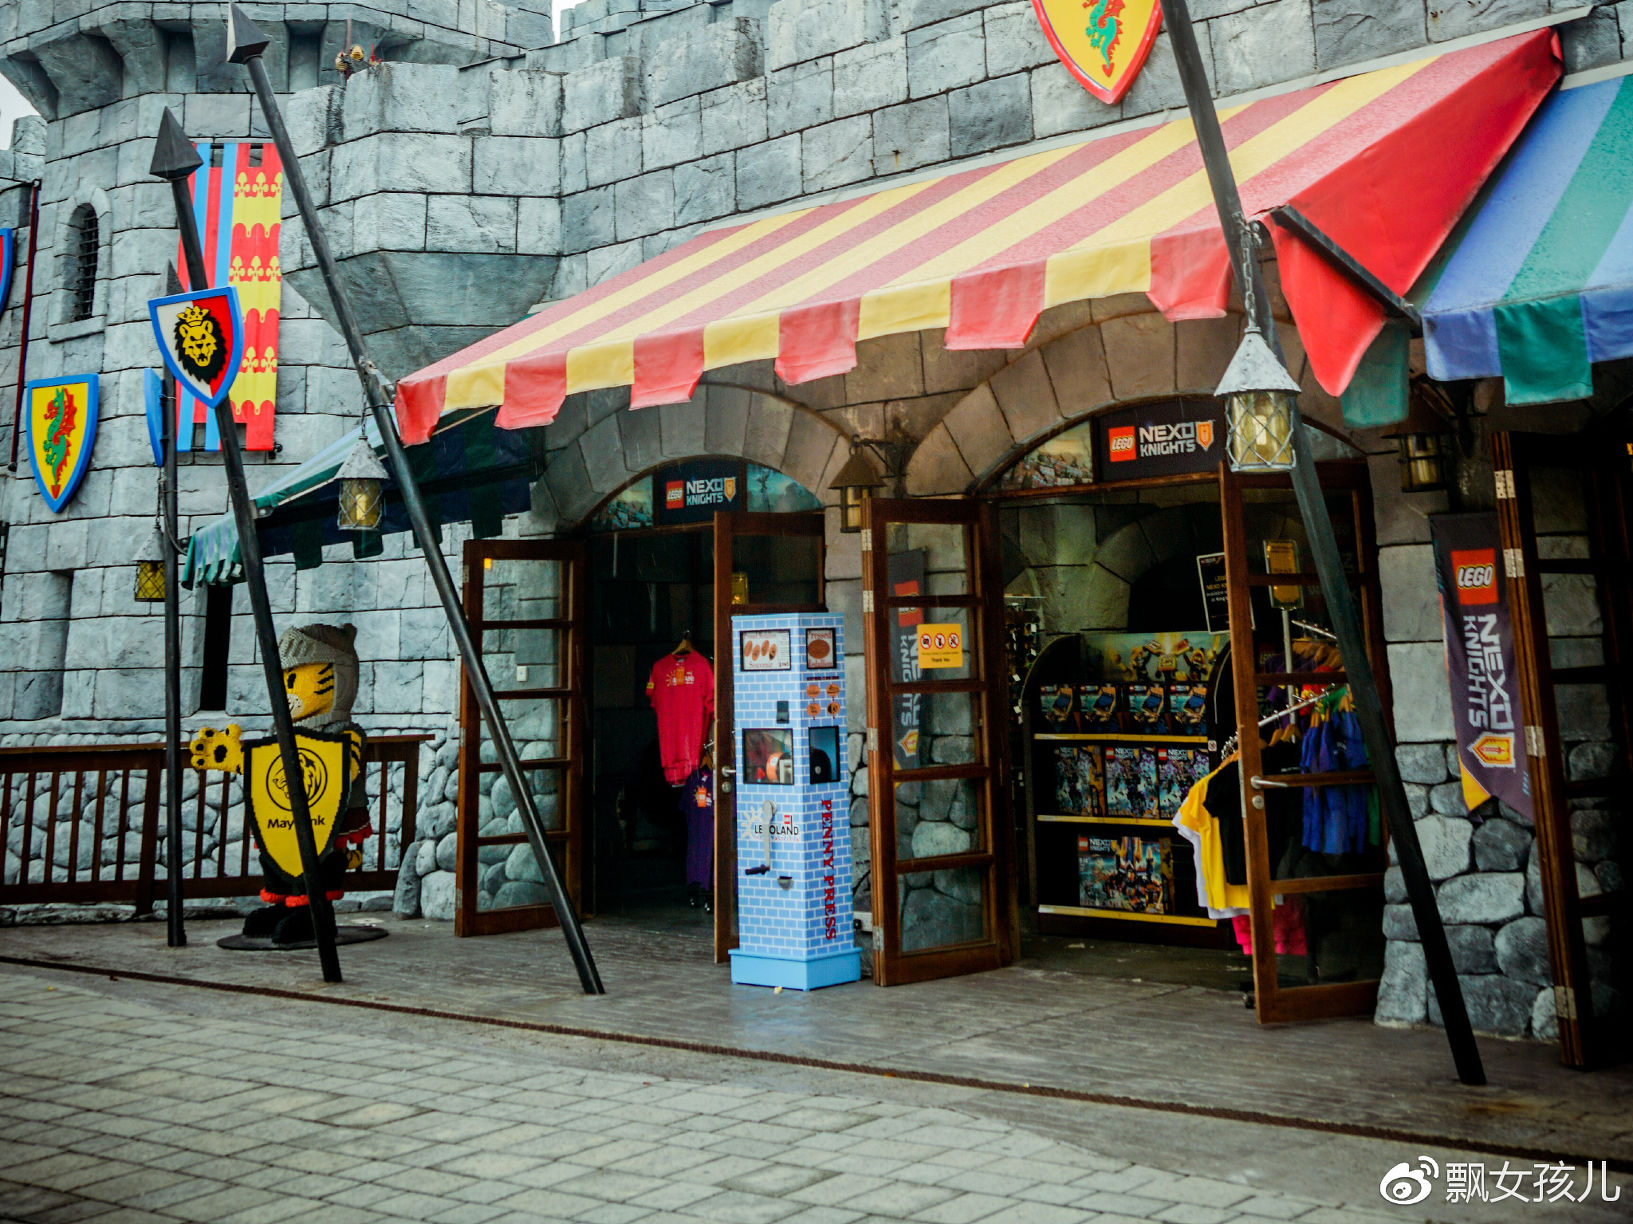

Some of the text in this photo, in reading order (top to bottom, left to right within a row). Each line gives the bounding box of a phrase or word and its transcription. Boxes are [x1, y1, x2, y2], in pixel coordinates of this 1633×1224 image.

[1139, 421, 1195, 443] NEXO
[1110, 435, 1134, 452] LEGO
[1140, 439, 1196, 458] KNIGHTS
[686, 478, 724, 494] NEXO
[686, 492, 724, 506] KNIGHTS
[1457, 564, 1495, 589] LEGO
[1463, 615, 1489, 728] KNIGHTS
[1477, 613, 1515, 730] NEXO
[267, 815, 326, 831] Maynk
[755, 822, 799, 836] LEOLAND
[821, 798, 835, 870] PENNY
[824, 874, 837, 941] PRESS
